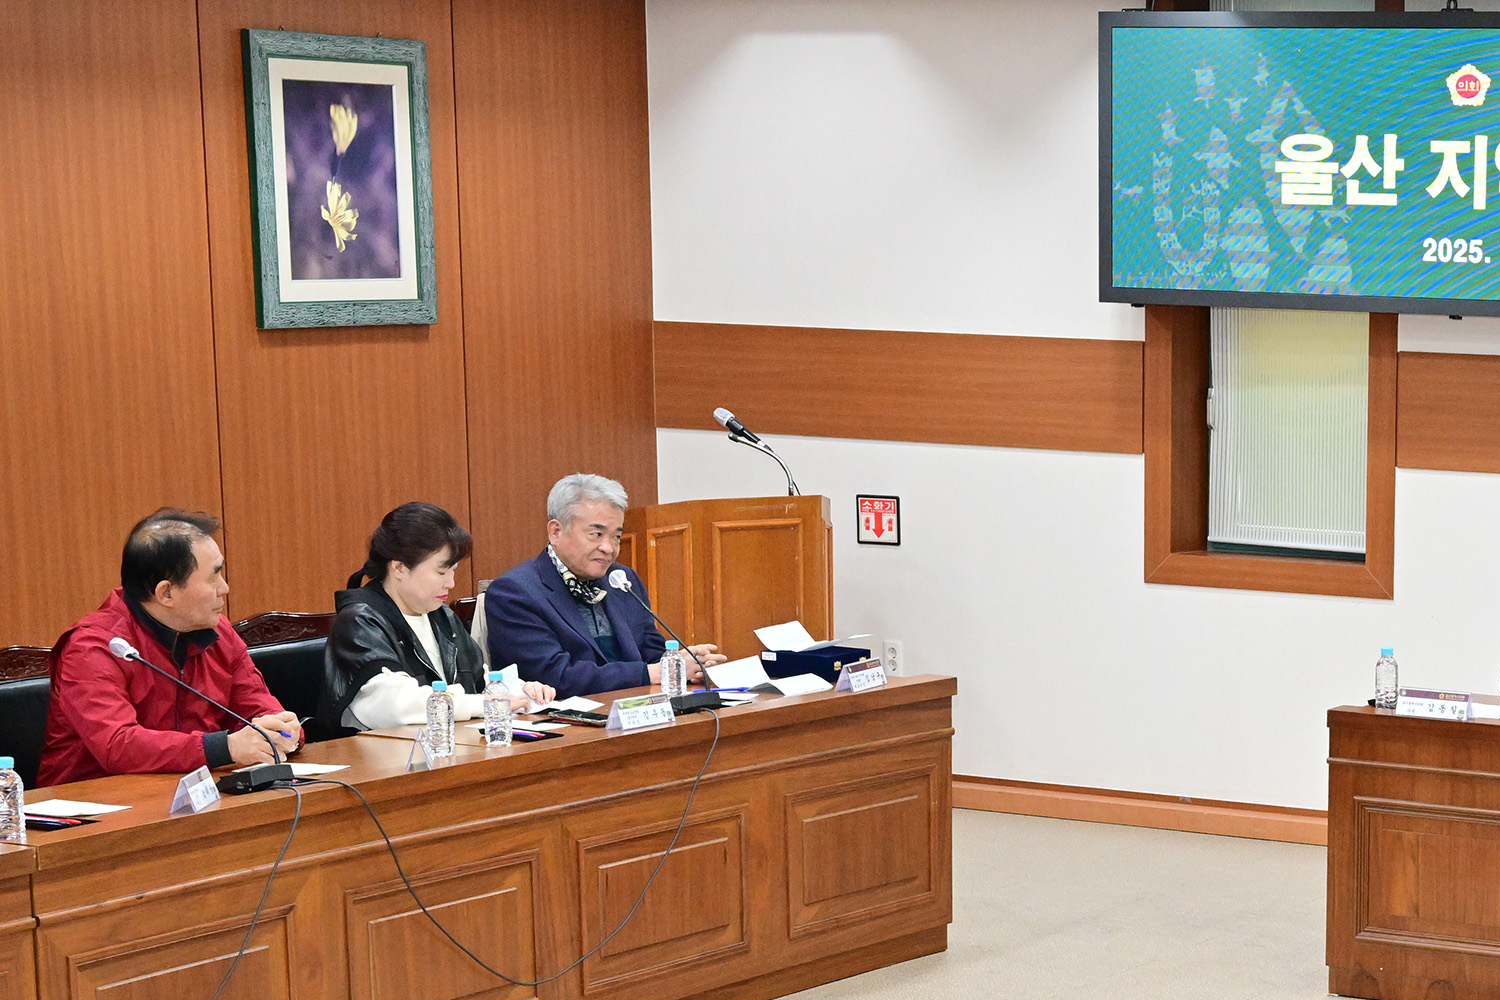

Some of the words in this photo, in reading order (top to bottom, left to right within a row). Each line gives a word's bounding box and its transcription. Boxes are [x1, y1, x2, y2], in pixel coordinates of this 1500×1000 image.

[1274, 133, 1405, 207] 울산
[1422, 237, 1492, 264] 2025.
[862, 501, 894, 510] 소화기
